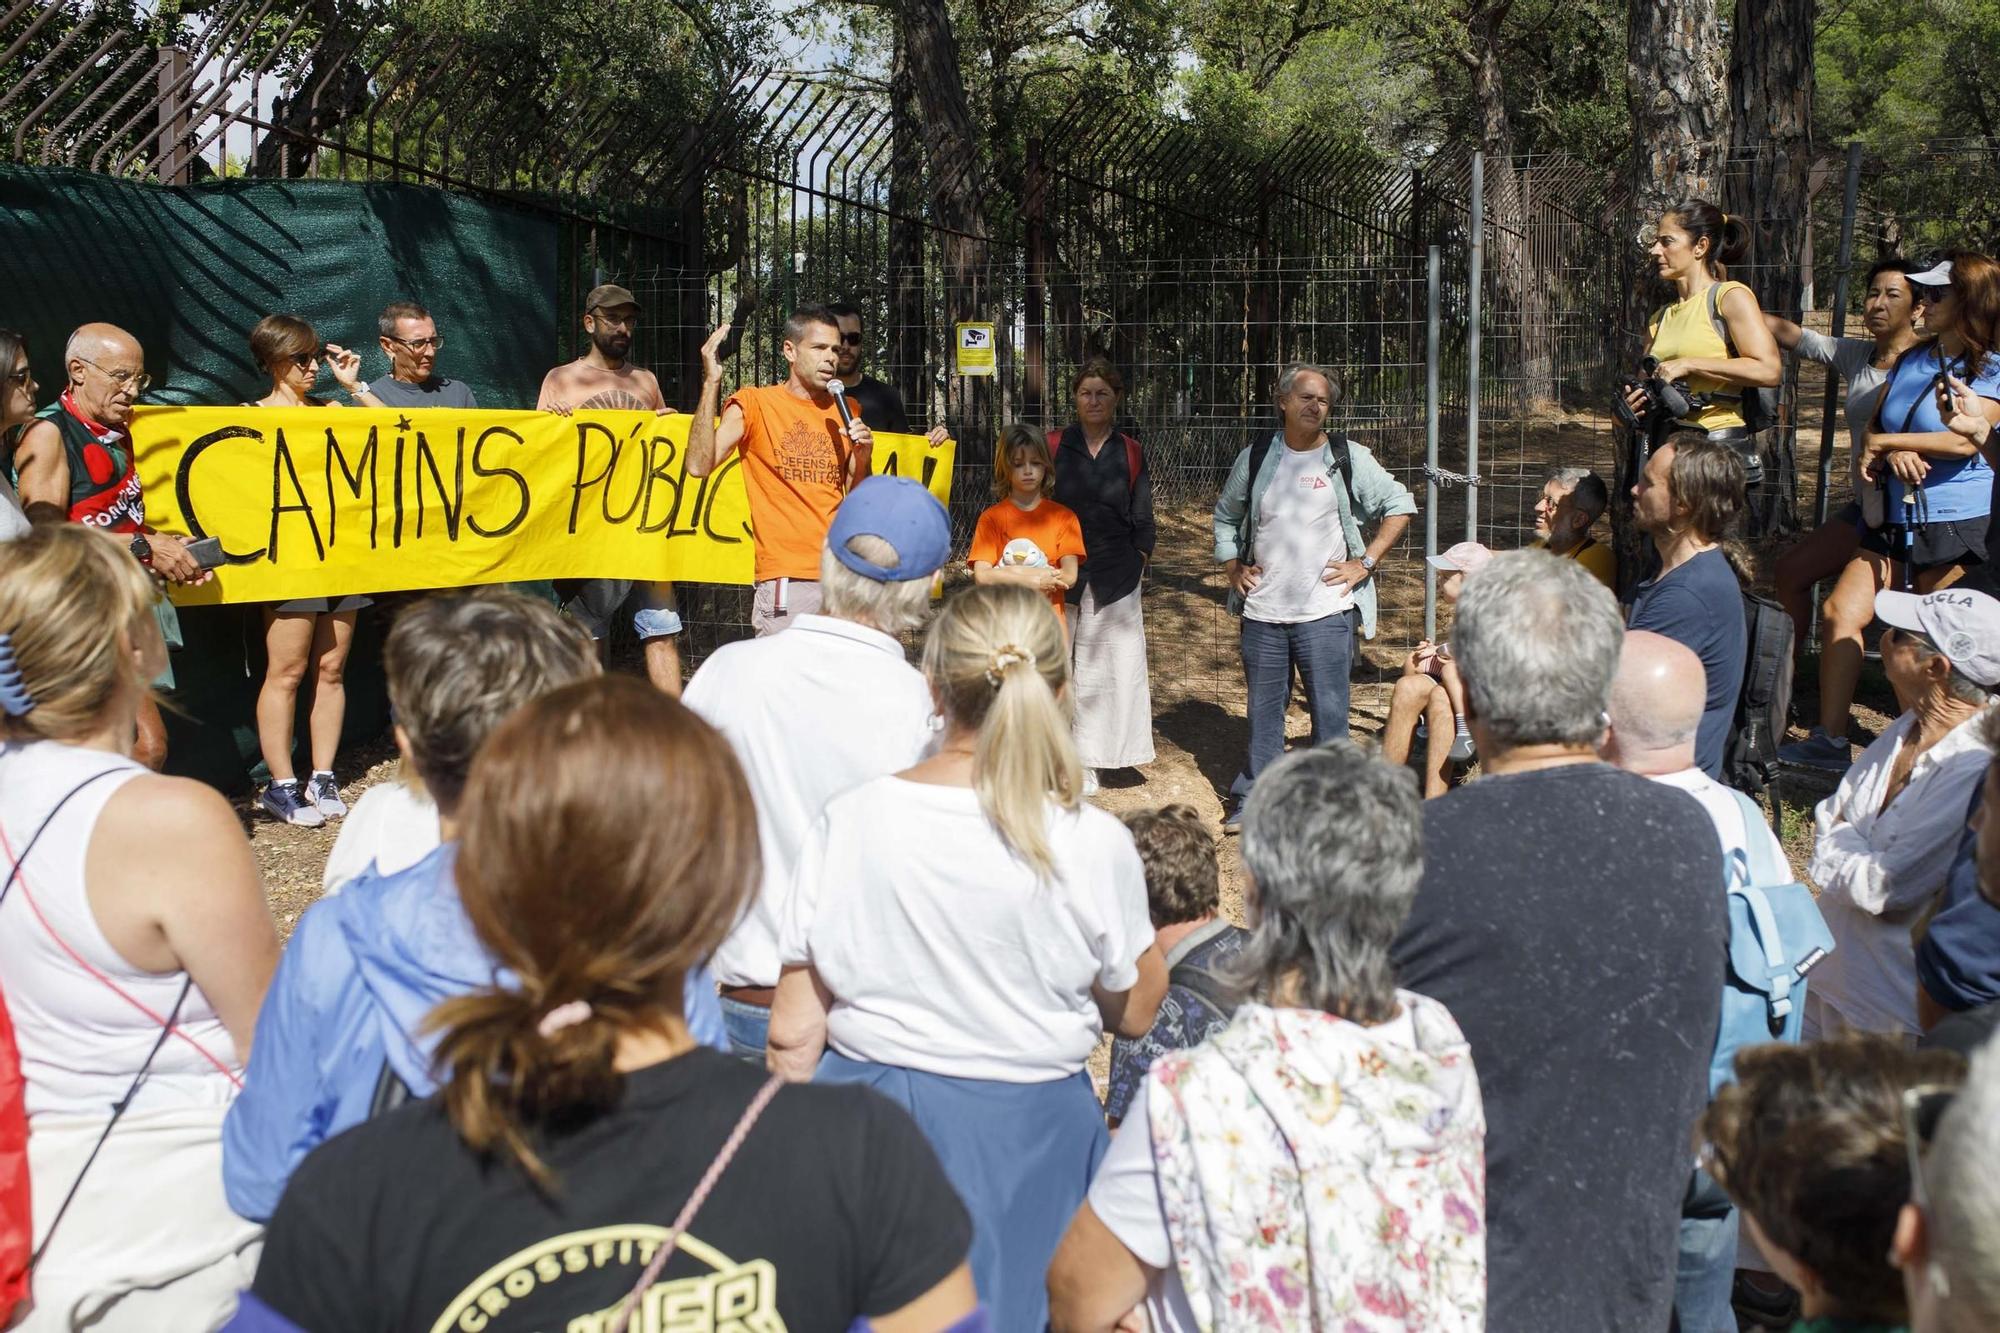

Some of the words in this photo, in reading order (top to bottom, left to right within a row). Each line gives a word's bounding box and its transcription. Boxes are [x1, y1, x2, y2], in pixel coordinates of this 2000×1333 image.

[568, 421, 754, 544] PÚBLIC
[1922, 593, 1974, 608] UCLA
[458, 1237, 662, 1333] CROSSFIT
